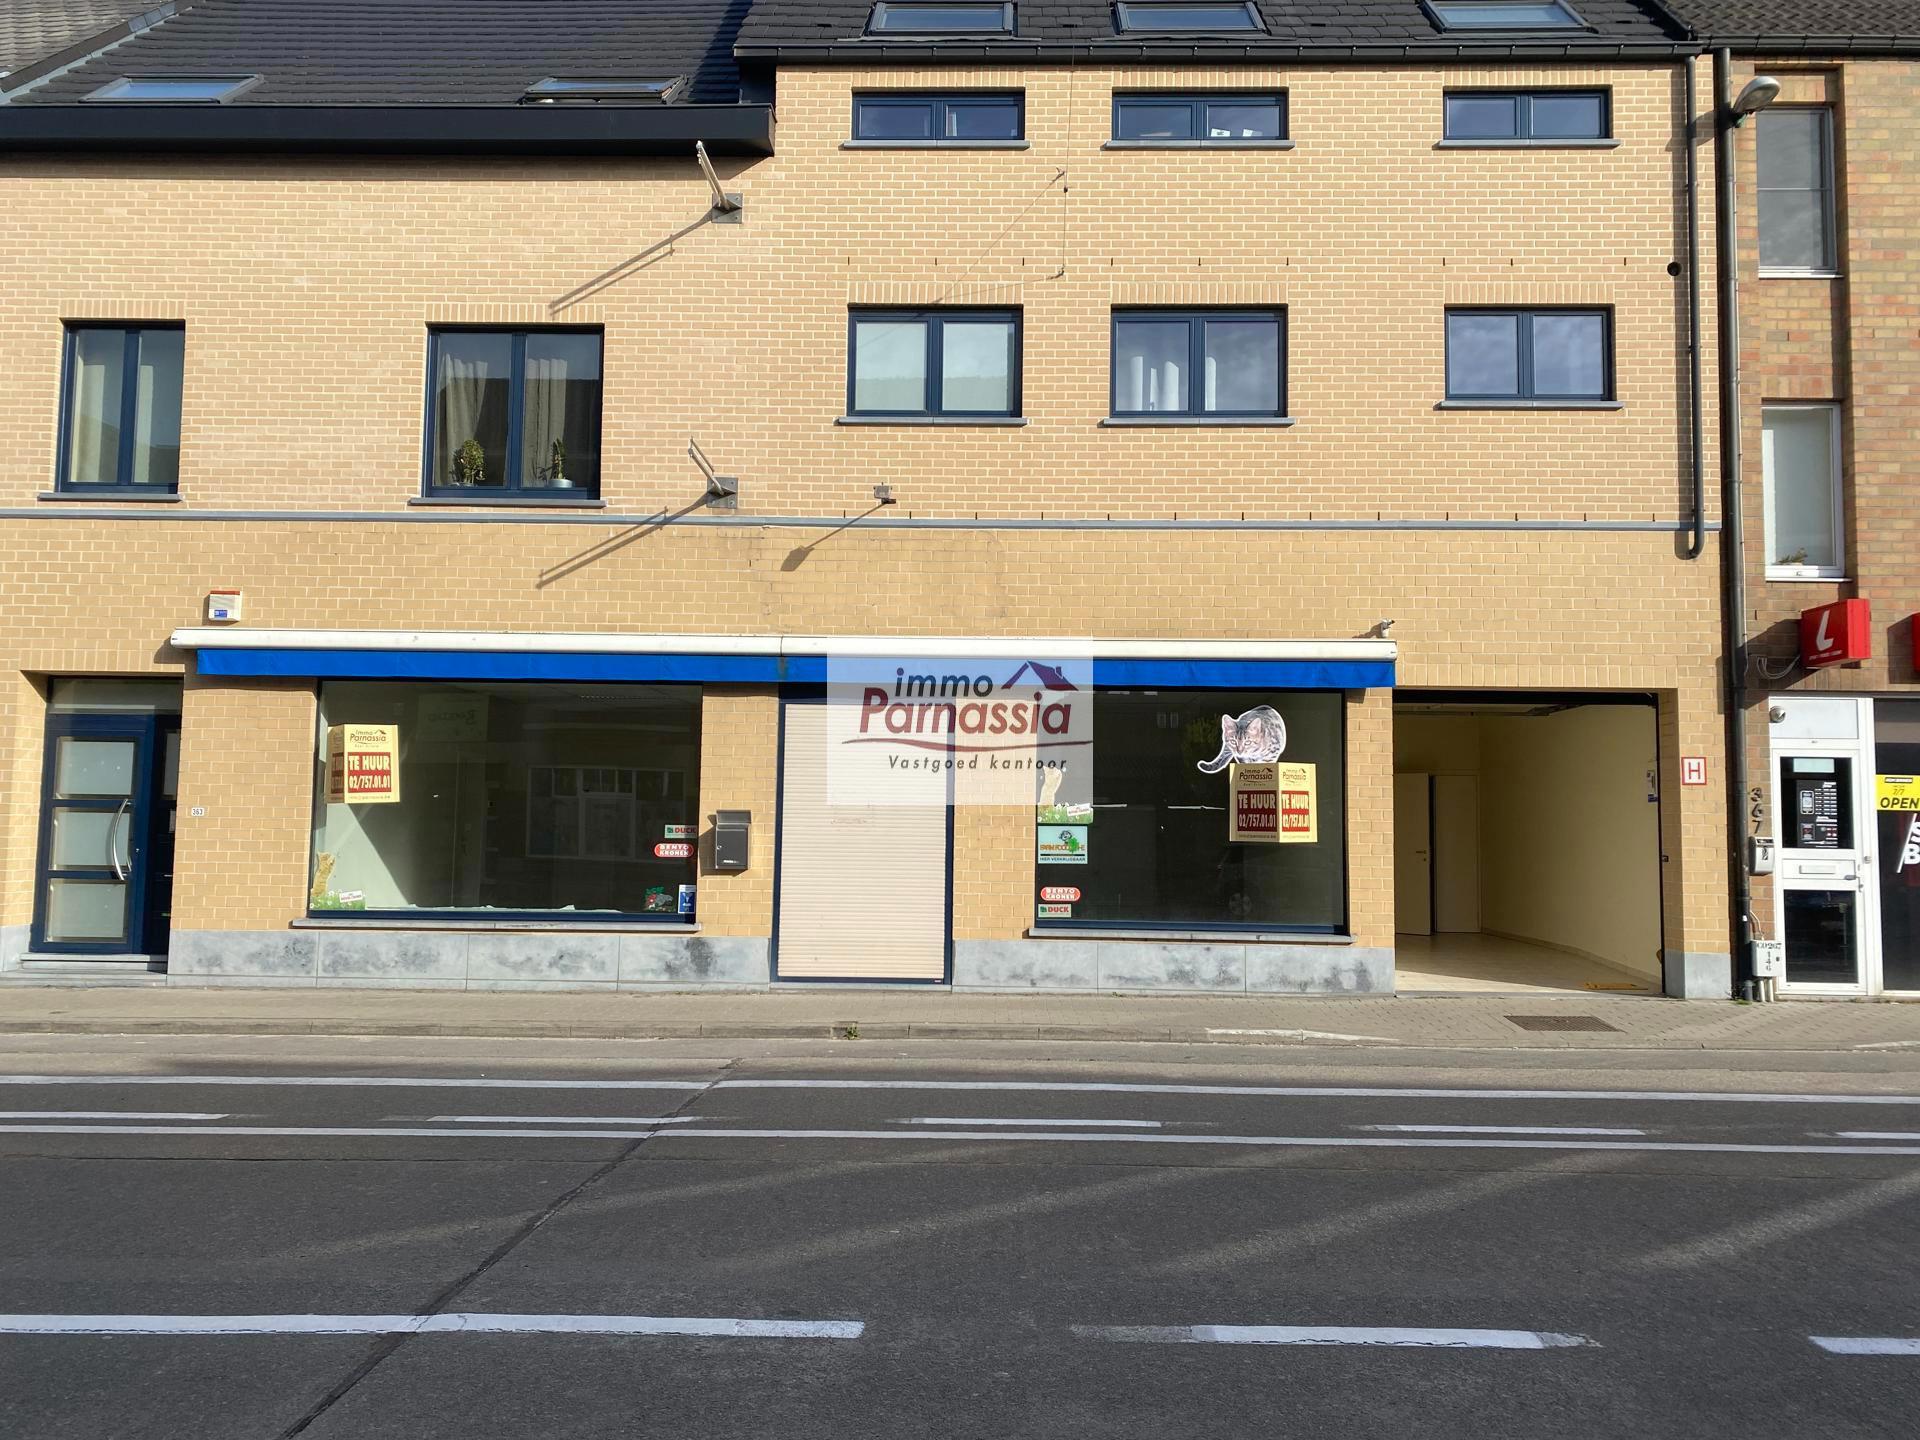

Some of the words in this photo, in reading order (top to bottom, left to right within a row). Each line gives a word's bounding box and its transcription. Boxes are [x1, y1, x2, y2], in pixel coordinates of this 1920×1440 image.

[349, 733, 387, 742] Parnassia
[348, 756, 360, 770] TE
[362, 756, 390, 770] HUUR
[1688, 761, 1701, 780] H
[349, 775, 391, 790] 02/757.01.01
[1239, 772, 1273, 780] Parnassia
[1238, 794, 1248, 809] TE
[1250, 794, 1276, 809] HUUR
[1282, 794, 1291, 809] TE
[1291, 794, 1309, 809] HUUR
[1880, 797, 1920, 809] OPEN
[1239, 814, 1276, 829] 02/757.01.01
